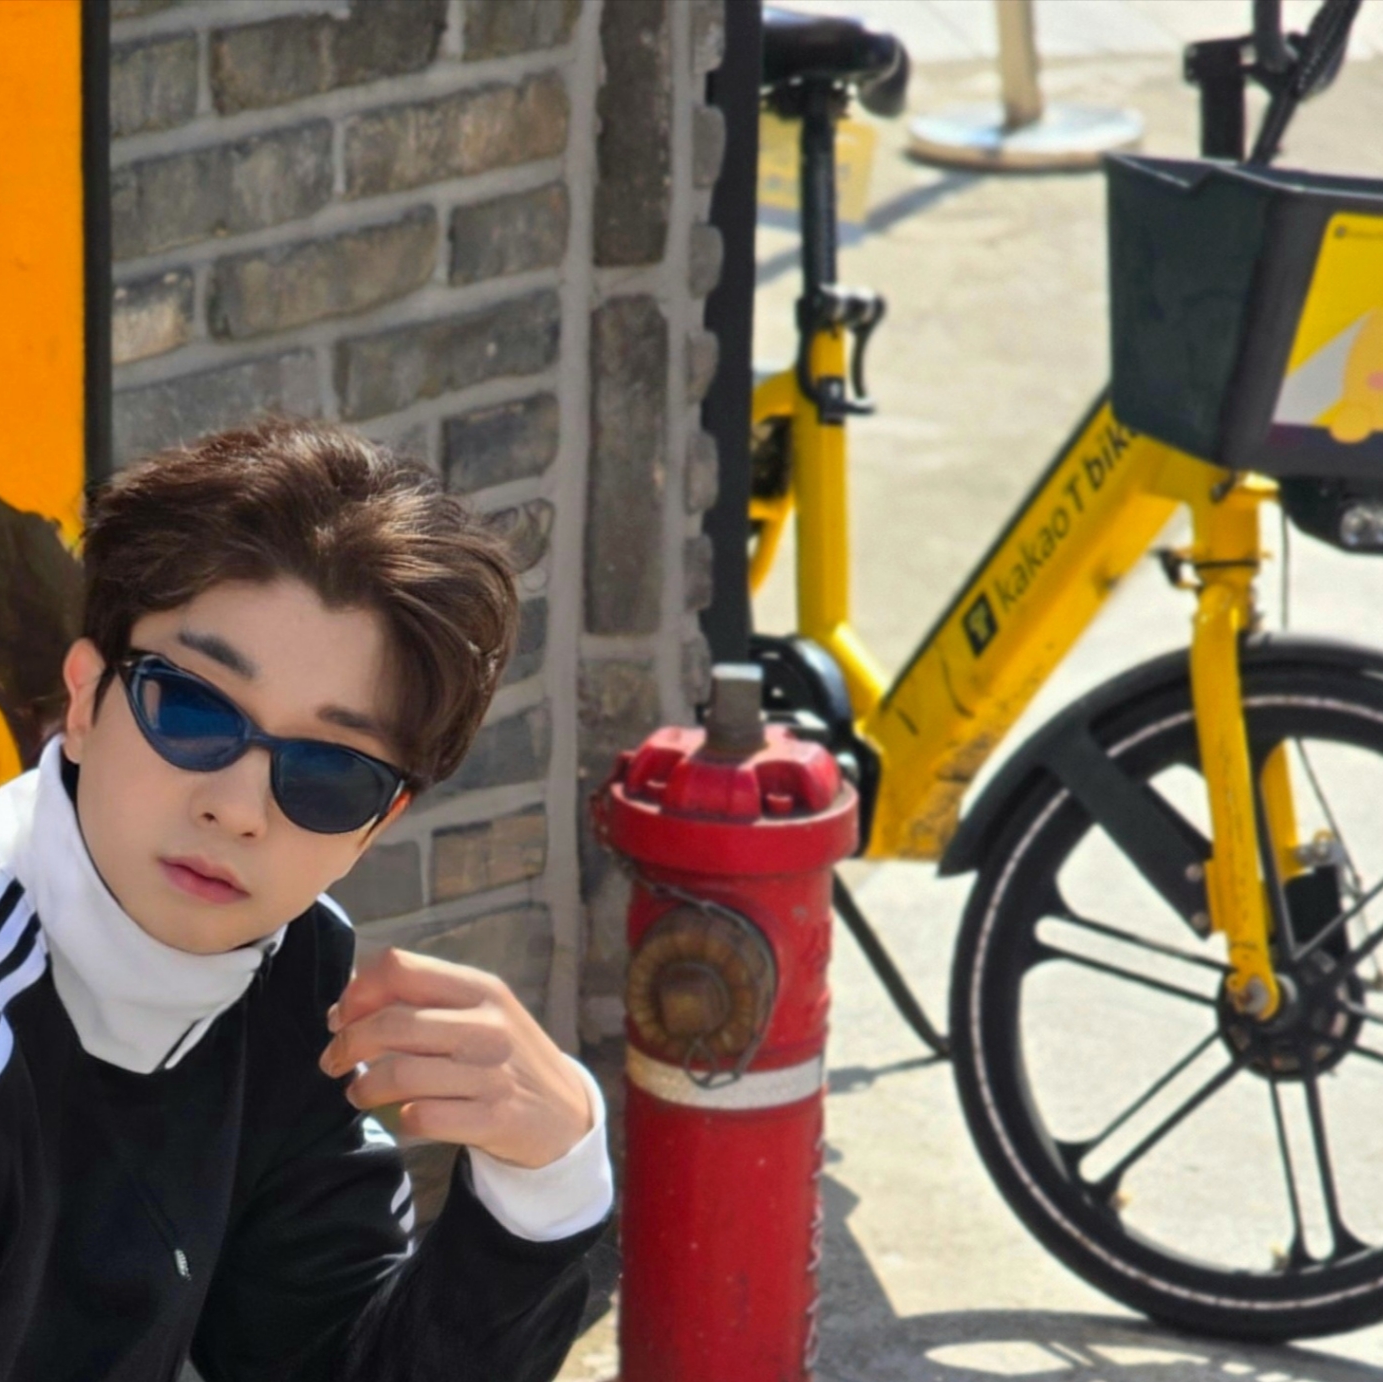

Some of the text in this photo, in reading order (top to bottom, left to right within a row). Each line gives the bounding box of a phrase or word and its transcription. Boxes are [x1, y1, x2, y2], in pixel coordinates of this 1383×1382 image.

[992, 504, 1070, 613] kakao
[1061, 472, 1084, 512] T
[1082, 422, 1136, 492] bik
